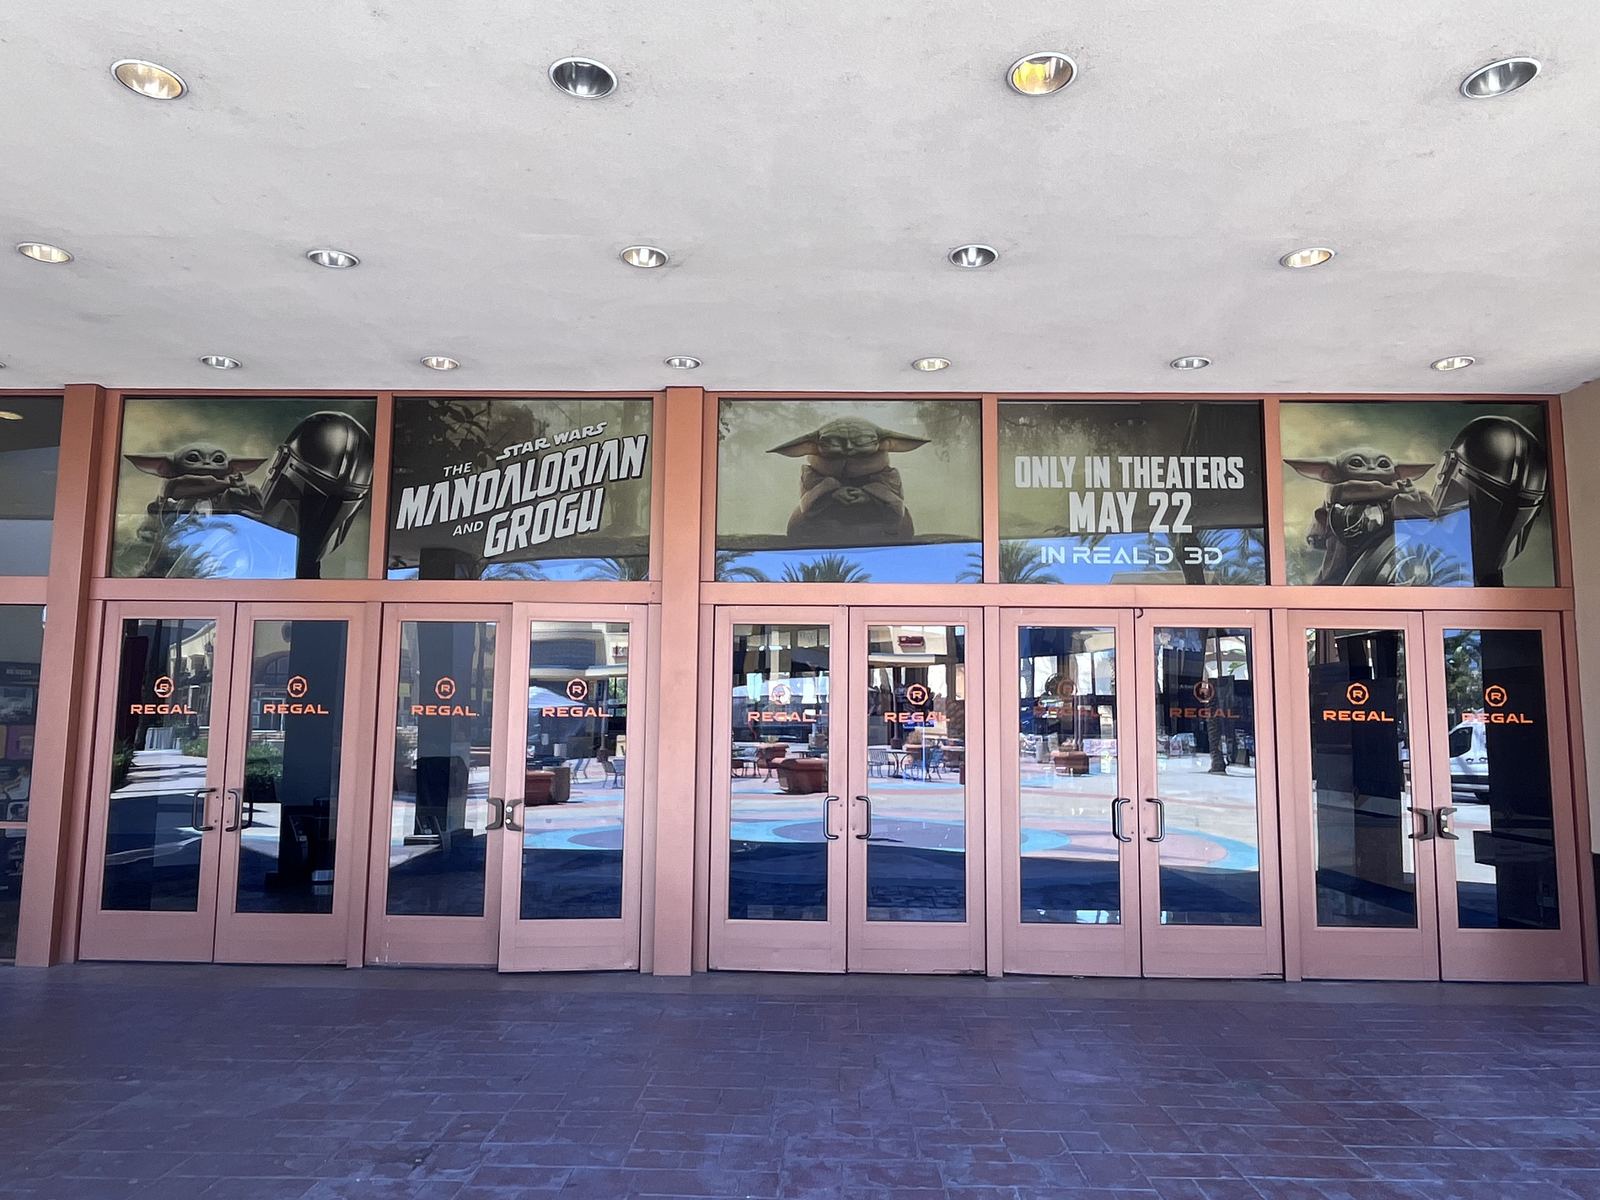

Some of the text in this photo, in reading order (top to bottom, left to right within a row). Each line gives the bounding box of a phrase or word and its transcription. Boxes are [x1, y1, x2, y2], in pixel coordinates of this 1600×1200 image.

[496, 422, 608, 461] STAR WARS
[443, 462, 472, 478] THE
[1014, 455, 1245, 490] ONLY IN THEATERS
[396, 435, 647, 531] MANDALORIAN
[1069, 491, 1193, 534] MAY 22
[452, 519, 484, 537] AND
[483, 487, 605, 558] GROGU
[1040, 546, 1066, 565] IN
[1184, 546, 1224, 565] 3D
[130, 704, 197, 715] REGAL
[263, 703, 329, 715] REGAL
[747, 711, 817, 723] REGAL
[884, 711, 951, 723] REGAL
[1169, 707, 1240, 719] REGAL
[1322, 710, 1395, 722] REGAL
[1461, 712, 1534, 724] REGAL
